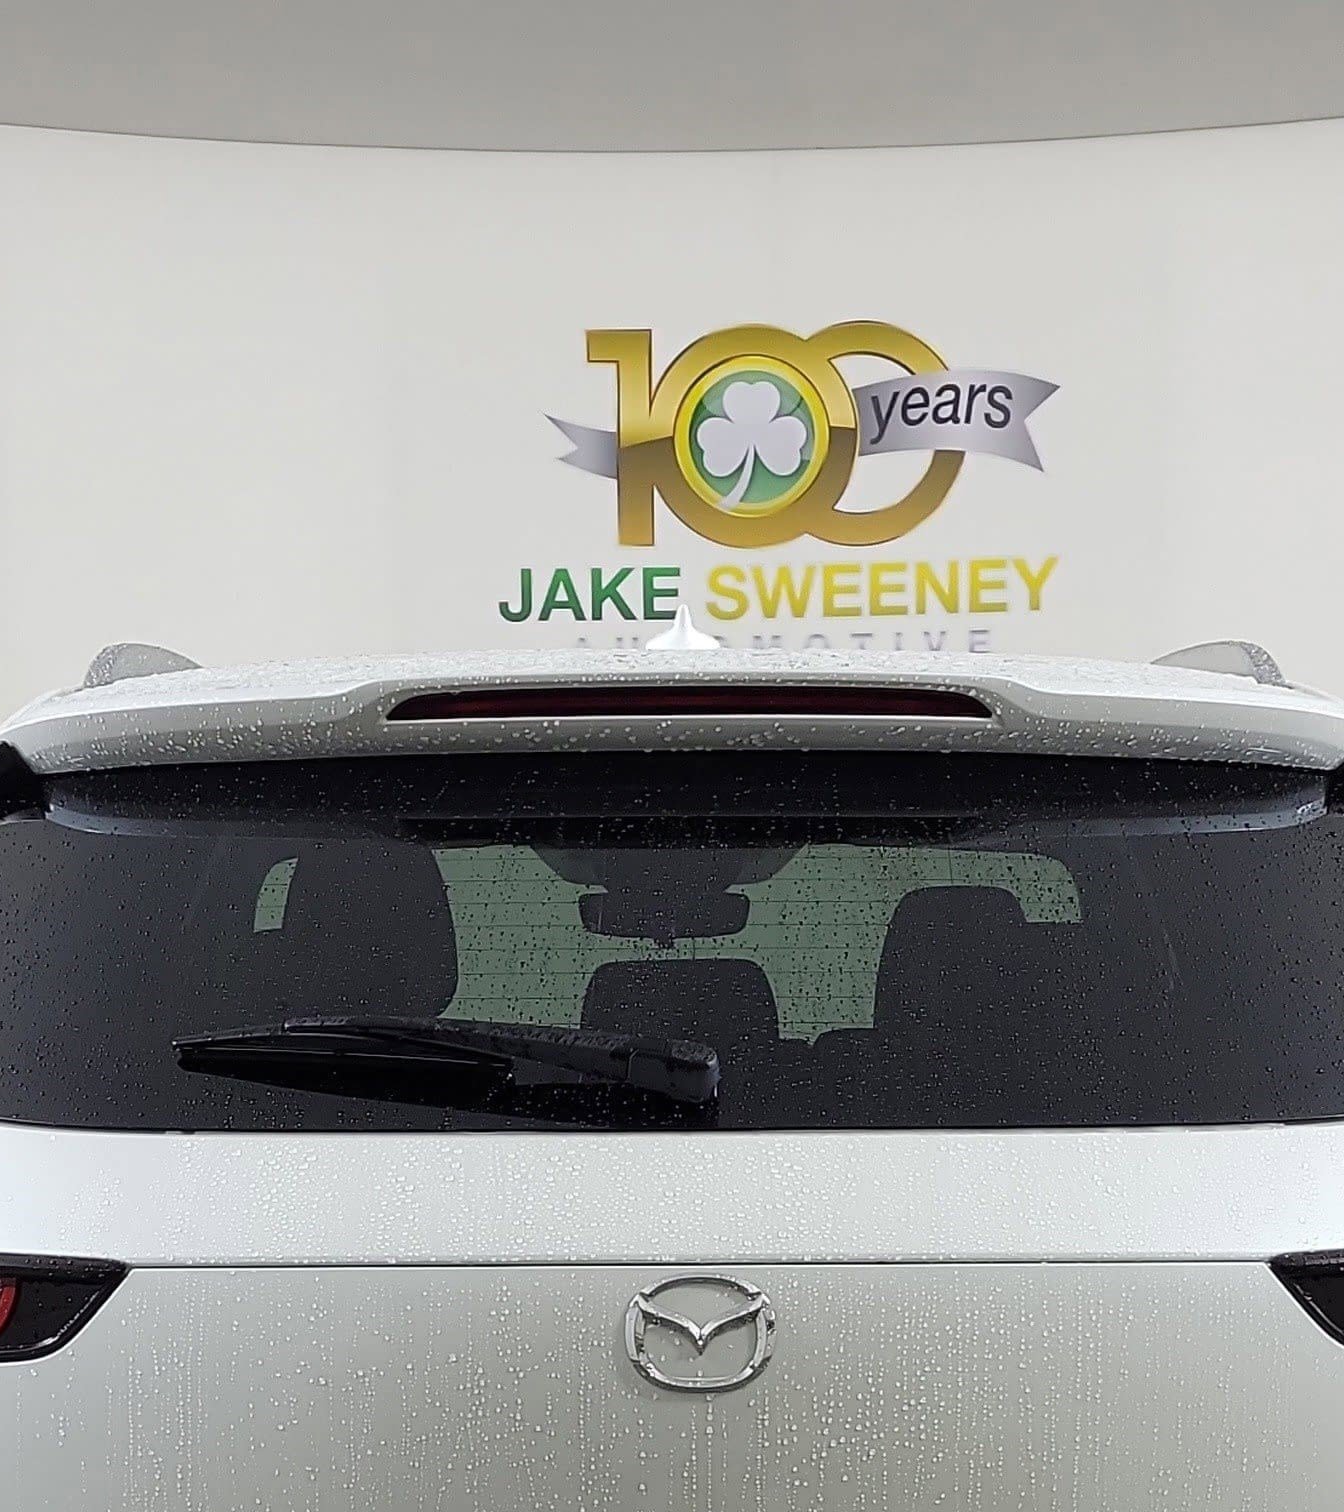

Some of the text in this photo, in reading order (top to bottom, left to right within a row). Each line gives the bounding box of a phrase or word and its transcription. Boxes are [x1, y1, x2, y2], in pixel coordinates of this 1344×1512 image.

[586, 320, 965, 549] 100
[869, 381, 1013, 446] years
[498, 557, 1059, 623] JAKE SWEENEY
